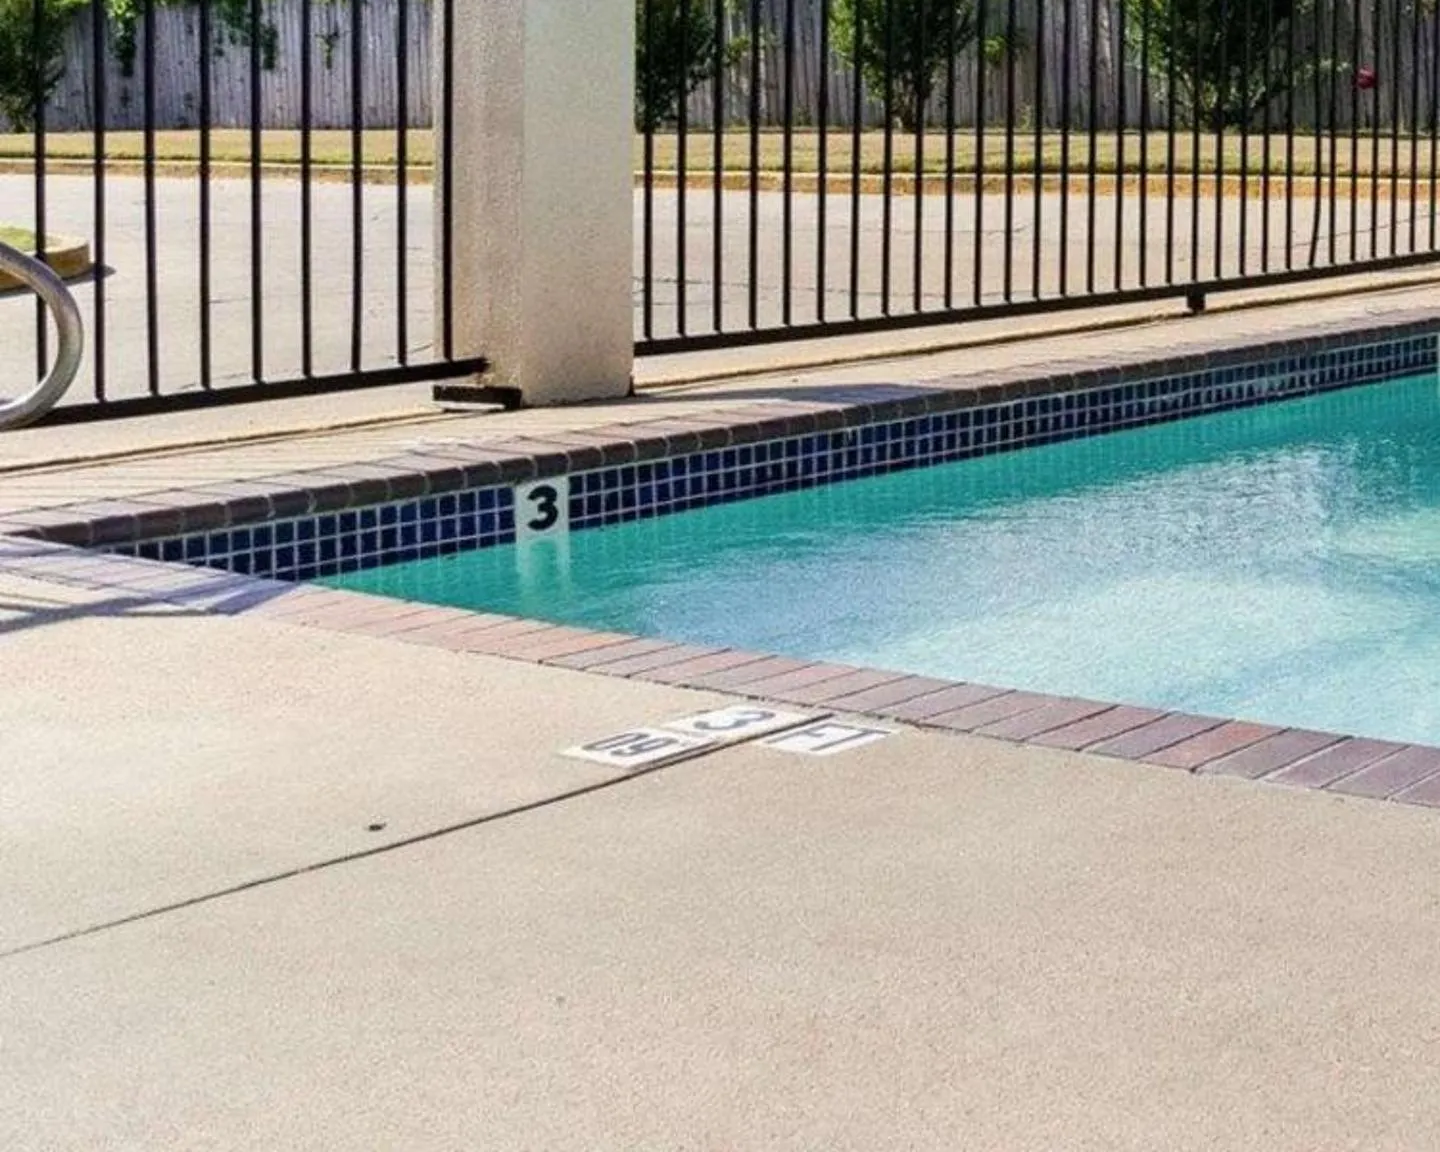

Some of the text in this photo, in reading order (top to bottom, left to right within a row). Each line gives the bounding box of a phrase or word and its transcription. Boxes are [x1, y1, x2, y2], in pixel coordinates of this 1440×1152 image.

[527, 485, 559, 531] 3
[693, 710, 892, 752] 3 FT
